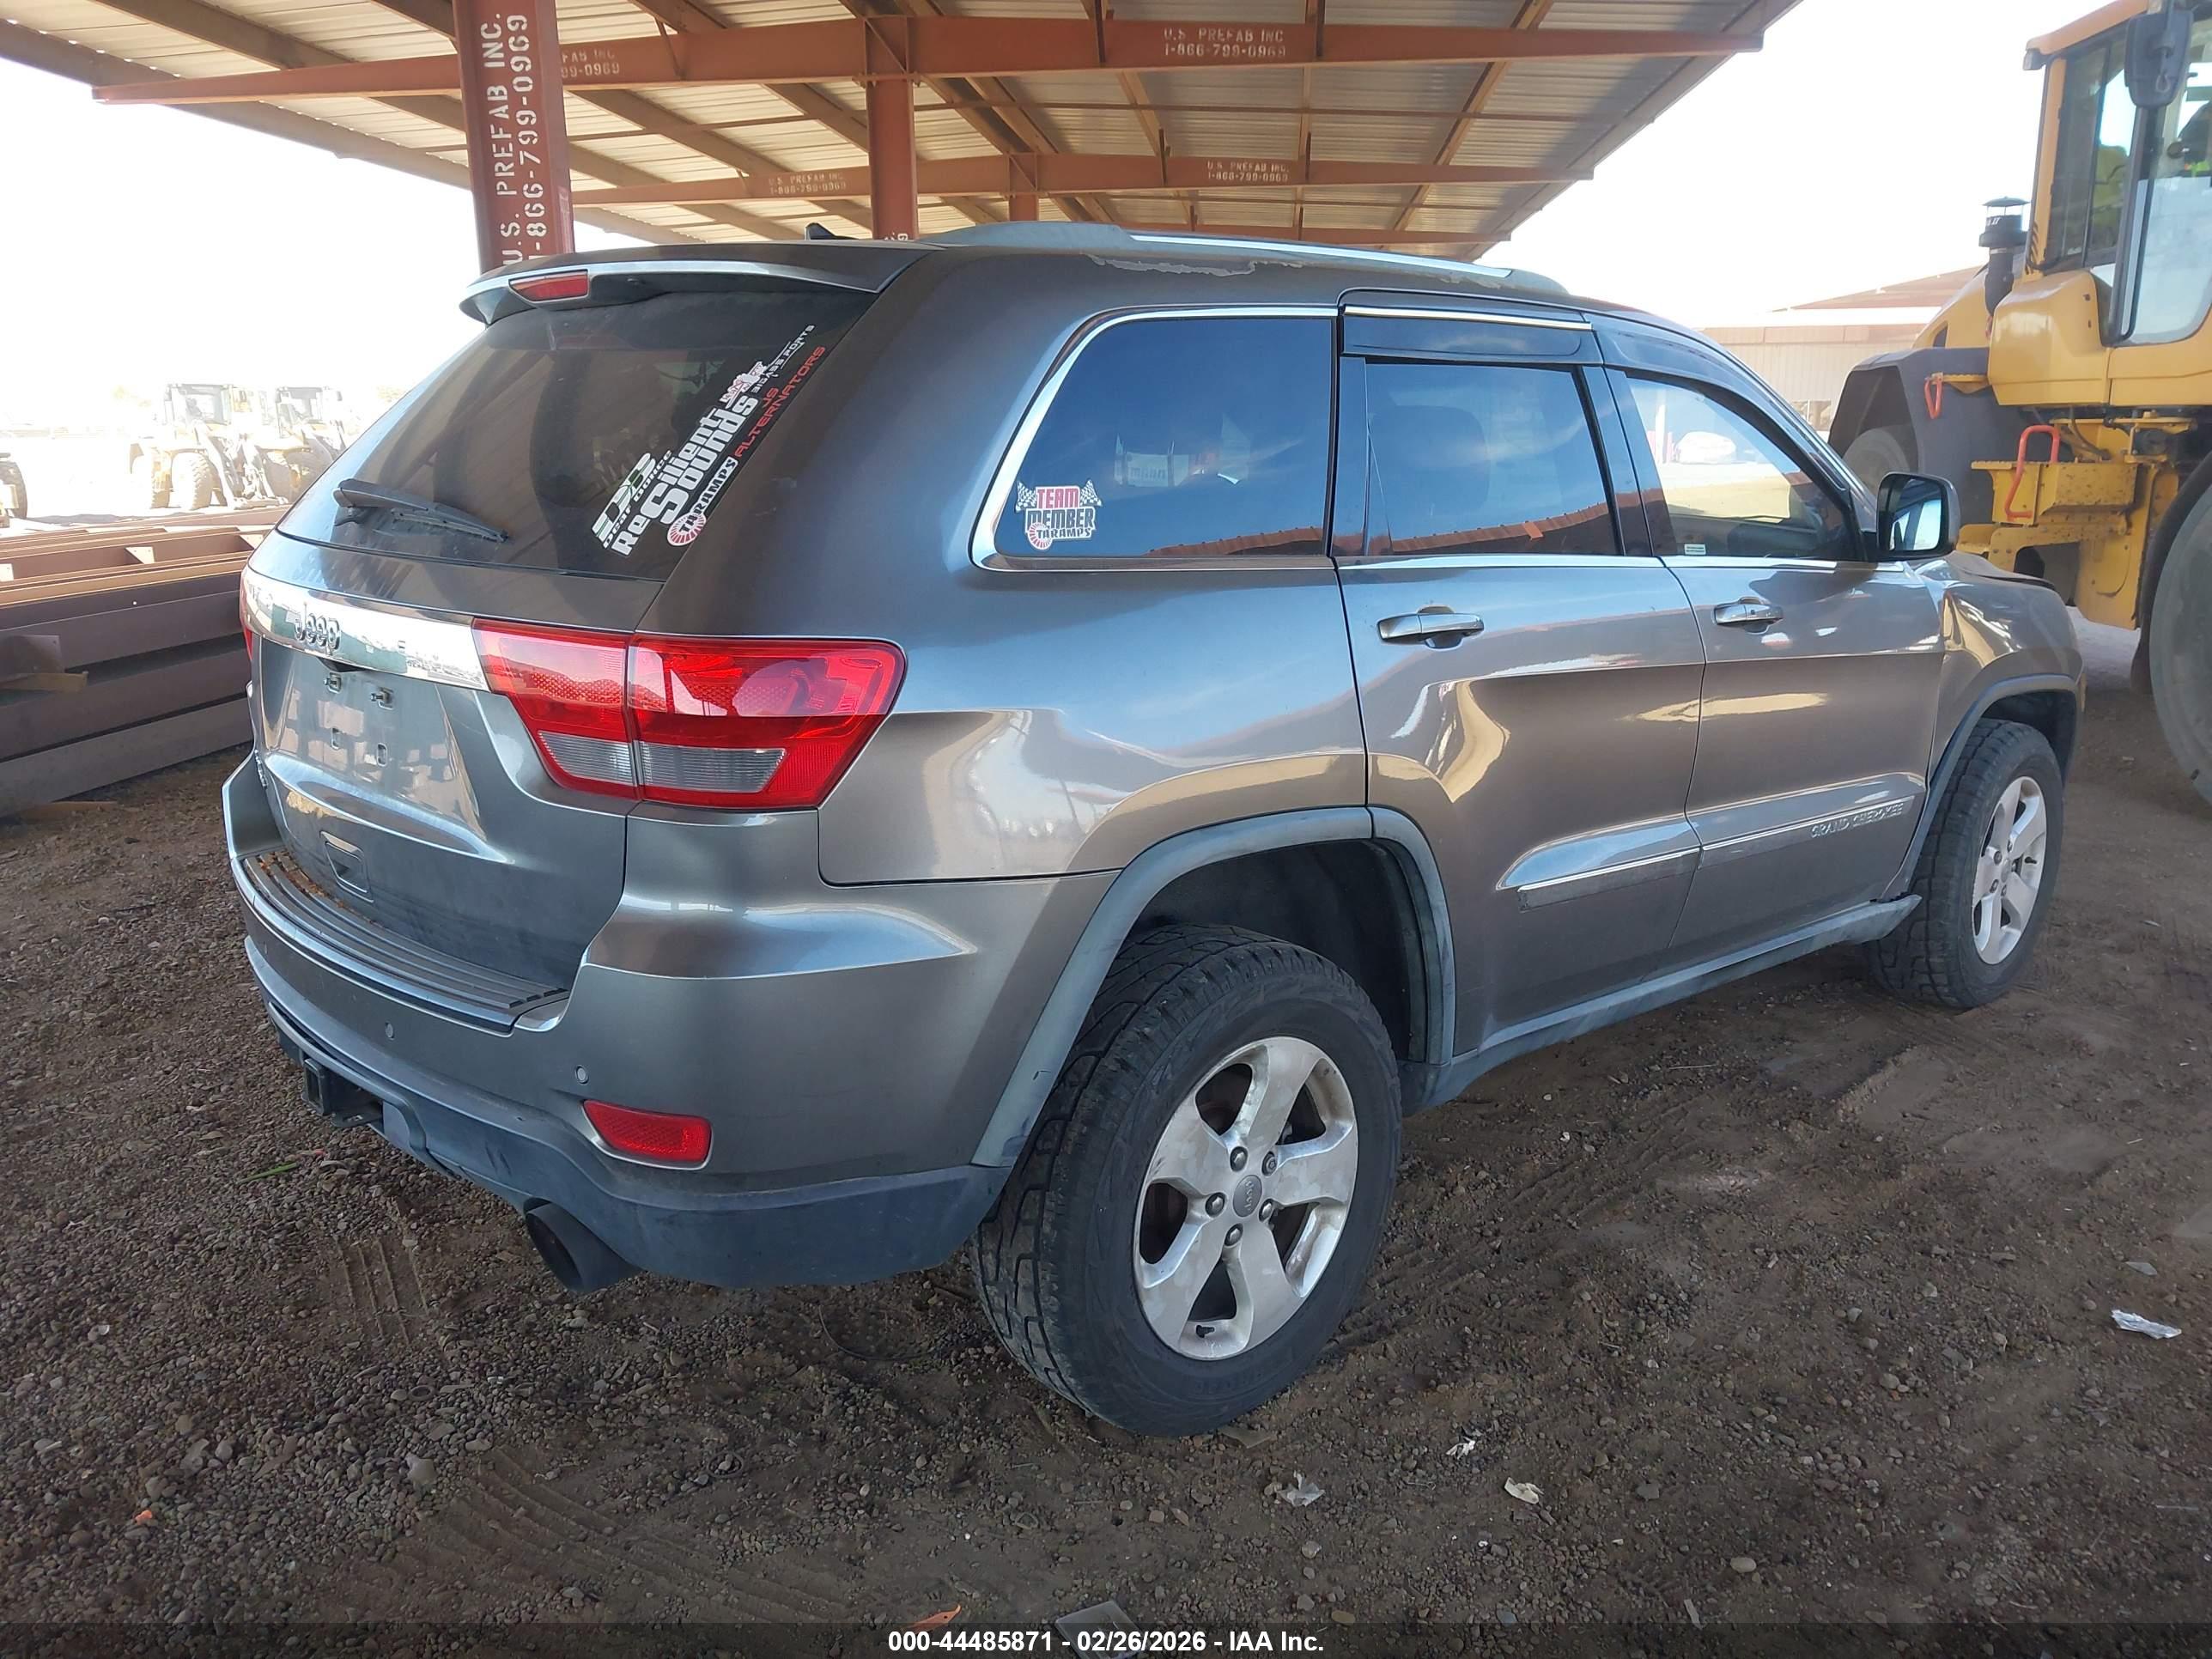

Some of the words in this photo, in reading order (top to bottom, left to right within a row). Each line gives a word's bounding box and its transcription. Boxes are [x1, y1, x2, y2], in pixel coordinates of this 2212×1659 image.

[481, 13, 505, 68] INC.
[1199, 27, 1254, 42] PREFAB
[487, 85, 517, 196] PREFAB
[734, 346, 825, 458] ALTERNATORS
[660, 395, 759, 525] Sounds
[678, 458, 738, 533] TARAMPS
[1027, 508, 1094, 532] MEMBER
[1037, 488, 1079, 508] TEAM
[1036, 527, 1091, 539] TARAMPS
[293, 601, 341, 656] Jeep
[1811, 817, 1850, 839] GRAND
